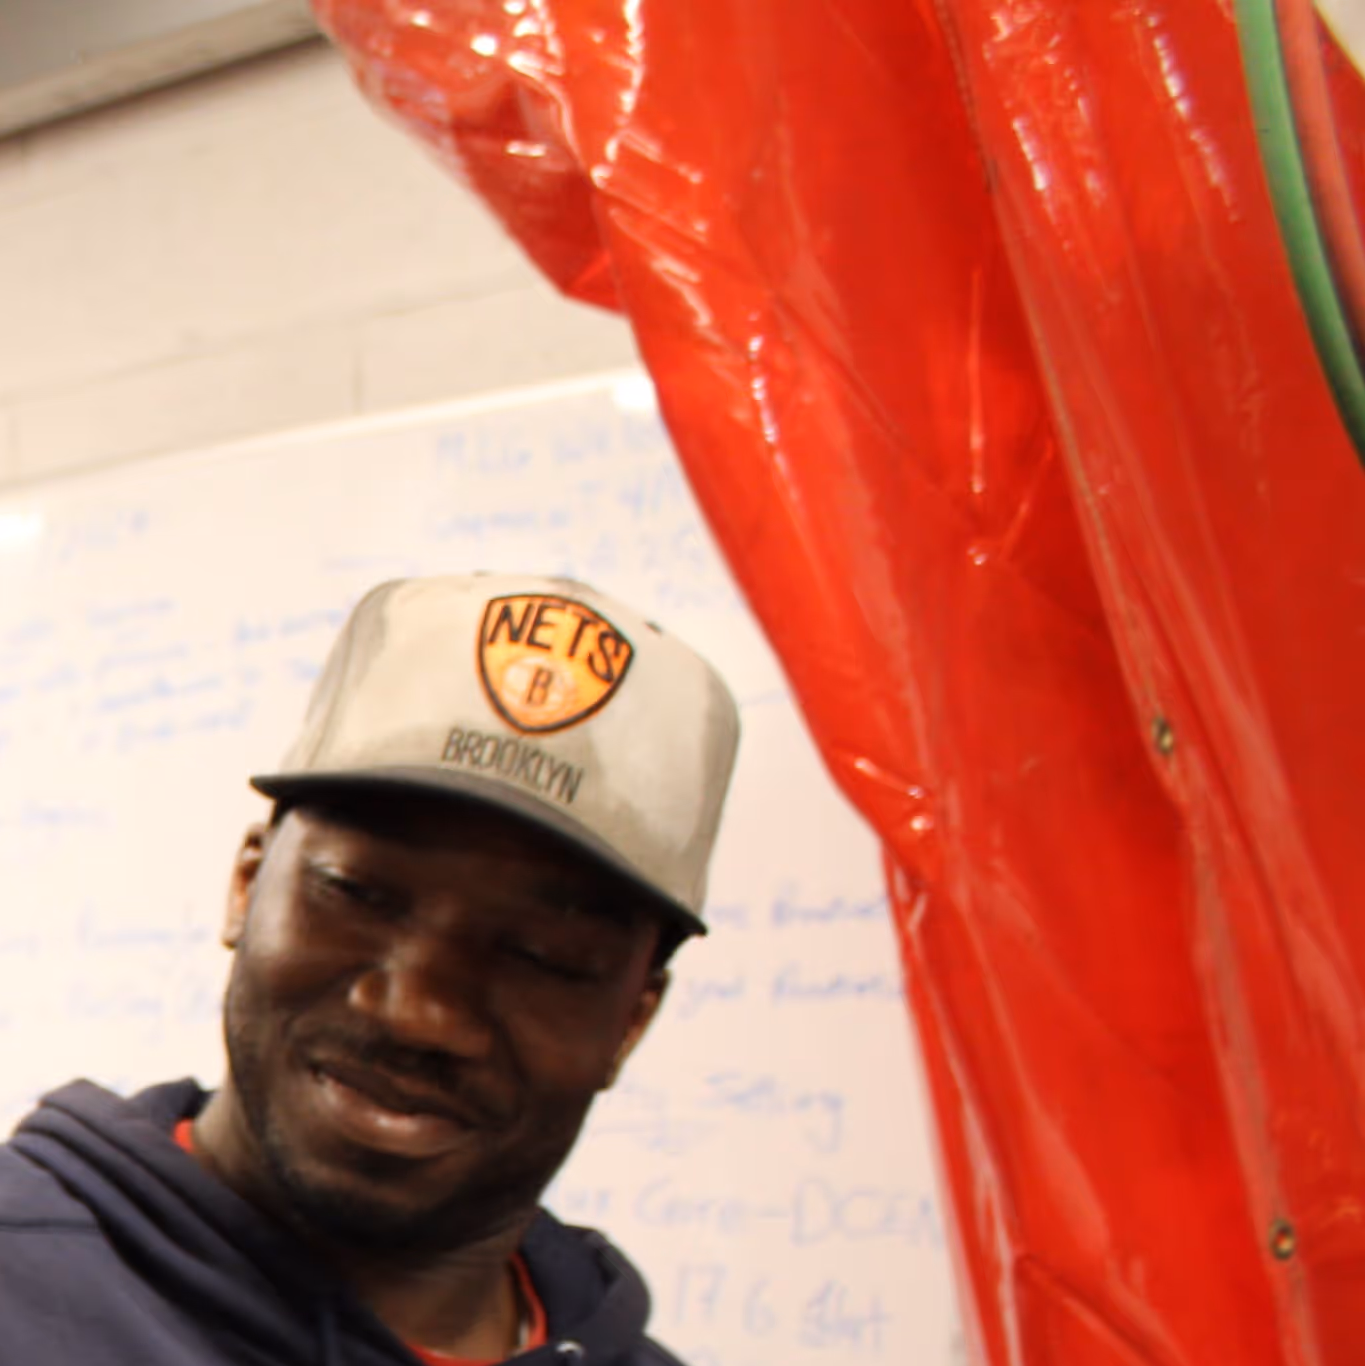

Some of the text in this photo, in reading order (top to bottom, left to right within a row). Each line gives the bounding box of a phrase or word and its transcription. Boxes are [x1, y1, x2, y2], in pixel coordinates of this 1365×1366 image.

[487, 602, 624, 684] NETS
[526, 667, 554, 705] B
[442, 728, 585, 806] BROOKLYN
